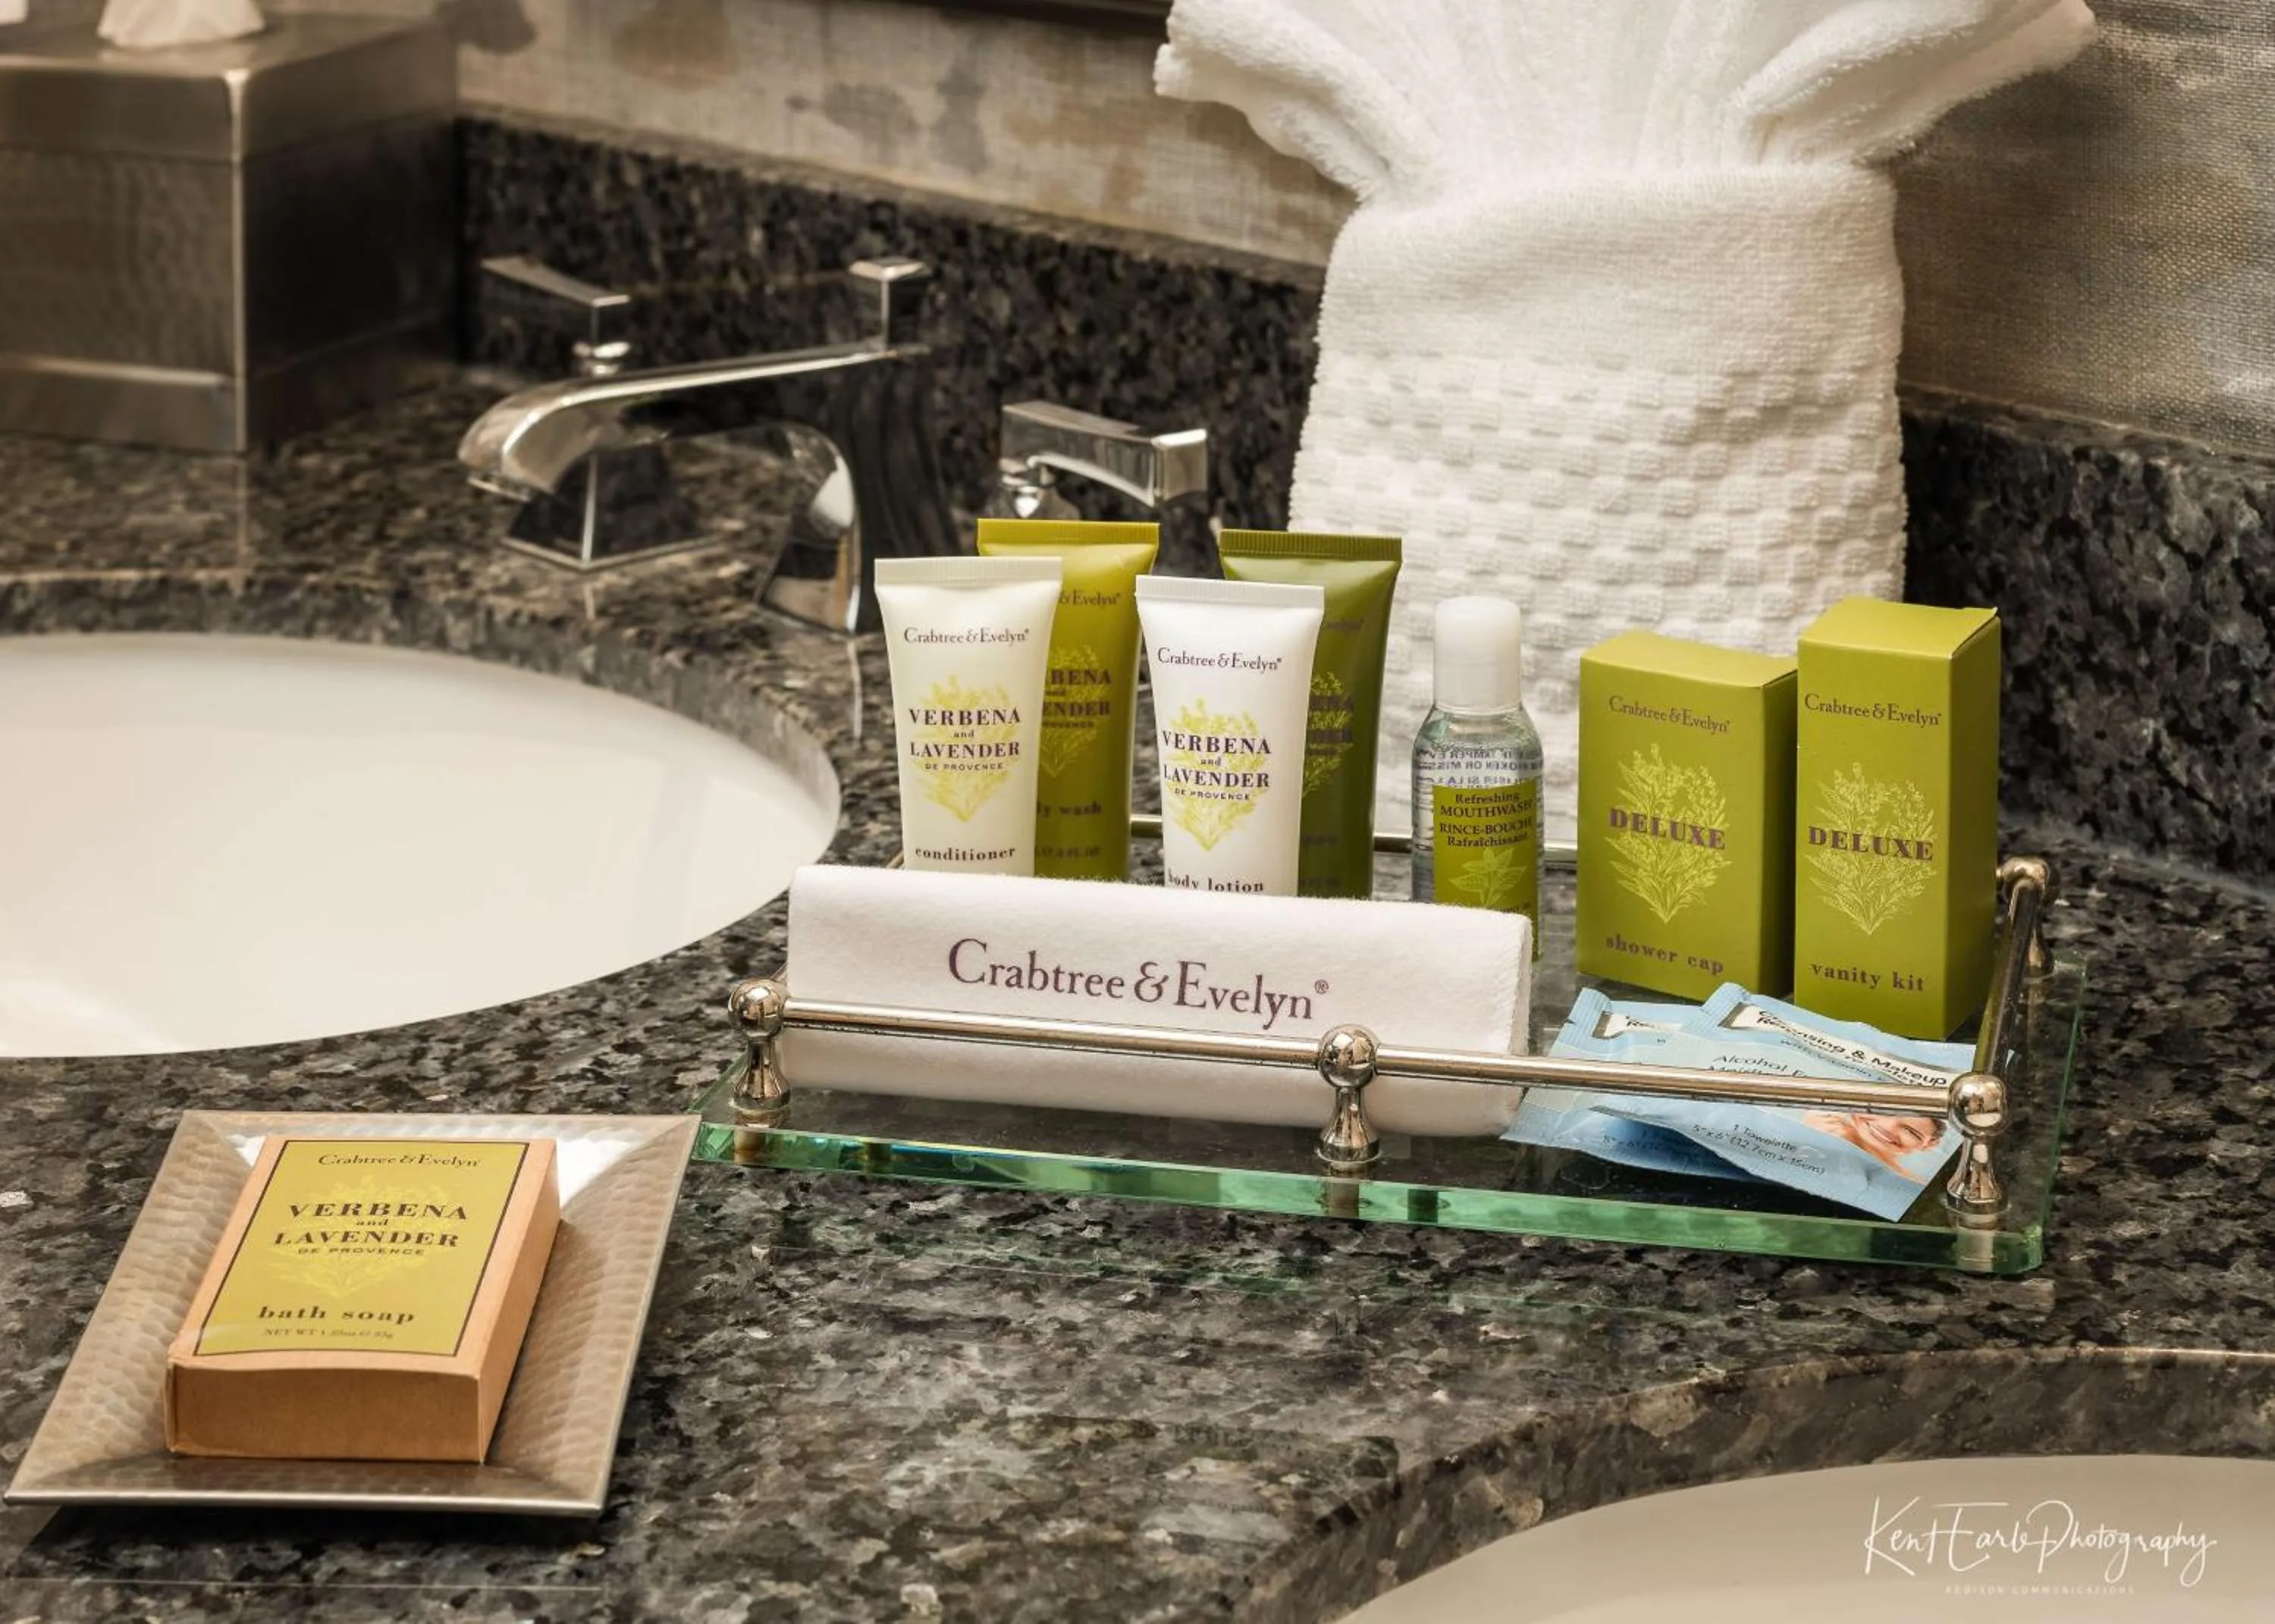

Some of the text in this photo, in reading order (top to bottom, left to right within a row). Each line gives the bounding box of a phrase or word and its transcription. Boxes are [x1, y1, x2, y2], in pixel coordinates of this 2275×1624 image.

[1045, 668, 1112, 685] BENA
[909, 707, 1021, 726] VERBENA
[1042, 701, 1111, 716] ENDER
[953, 729, 974, 738] and
[1162, 730, 1272, 755] VERBENA
[910, 741, 1021, 759] LAVENDER
[925, 761, 1004, 772] DE PROVENCE
[1200, 757, 1222, 767] and
[1163, 763, 1271, 788] LAVENDER
[1174, 787, 1251, 801] DE PROVENCE
[1455, 792, 1520, 804] Refreshing
[1440, 798, 1533, 818] MOUTHWASH
[1608, 807, 1726, 850] DELUXE
[1808, 825, 1935, 861] DELUXE
[915, 846, 1016, 864] conditioner
[1207, 878, 1264, 893] lotion
[1605, 934, 1724, 975] shower cap
[1810, 962, 1925, 992] vanity kit
[1712, 1055, 1788, 1072] Alcohol
[1872, 1056, 1947, 1086] Makeup
[1743, 1125, 1798, 1153] Towelette
[289, 1202, 468, 1220] VERBENA
[355, 1218, 388, 1227] and
[274, 1231, 460, 1247] LAVENDER
[328, 1247, 425, 1256] PROVENCE
[259, 1306, 415, 1325] bath soap
